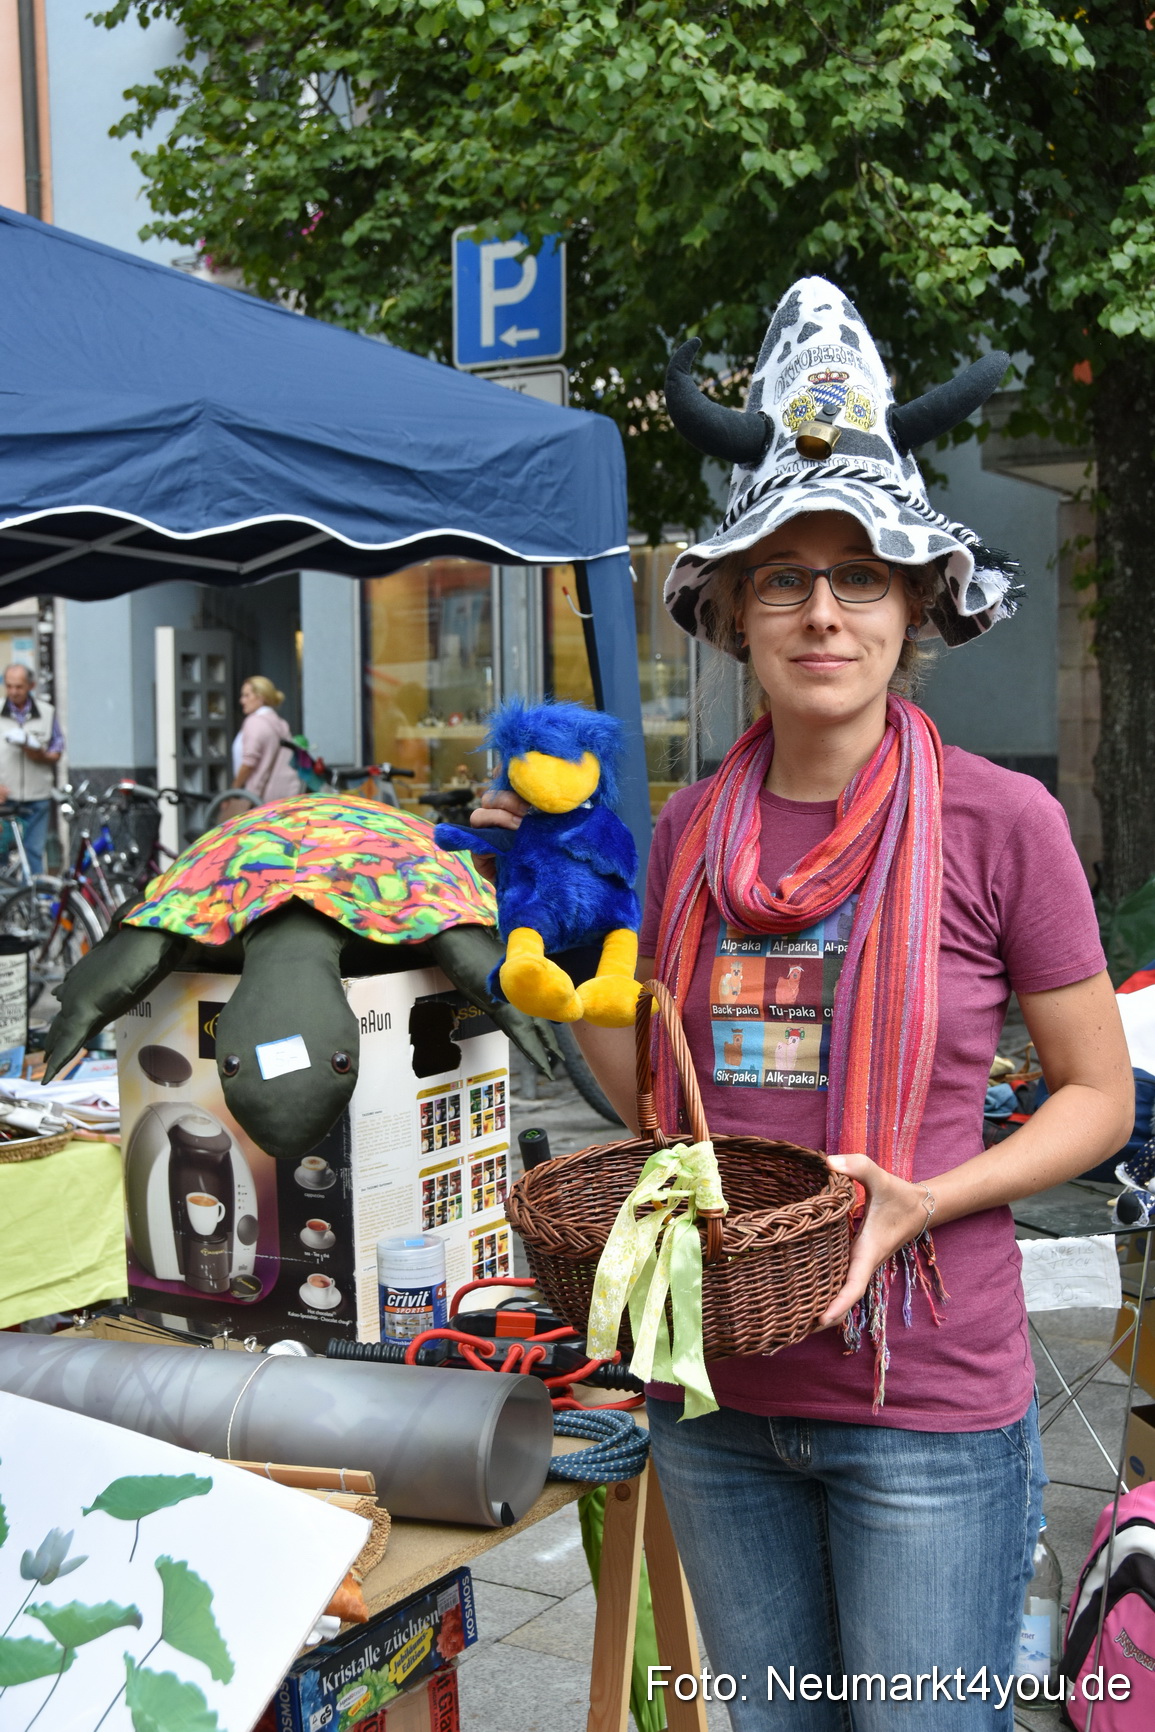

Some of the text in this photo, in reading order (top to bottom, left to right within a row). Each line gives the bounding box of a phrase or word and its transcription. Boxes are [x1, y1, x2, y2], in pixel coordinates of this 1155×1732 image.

[480, 240, 538, 347] P
[772, 940, 819, 953] Al-parka
[360, 1009, 392, 1035] RAUN
[712, 1005, 760, 1016] Back-paka
[769, 1005, 816, 1018] Tu-paka
[716, 1070, 758, 1084] Six-paka
[765, 1071, 816, 1085] Alk-paka
[386, 1290, 430, 1307] crivit
[395, 1306, 426, 1314] SPORTS
[461, 1574, 476, 1639] KOSMOS
[321, 1609, 440, 1696] Kristalle züchten
[401, 1645, 426, 1674] Edition
[320, 1705, 332, 1725] GS
[438, 1691, 454, 1732] Gla
